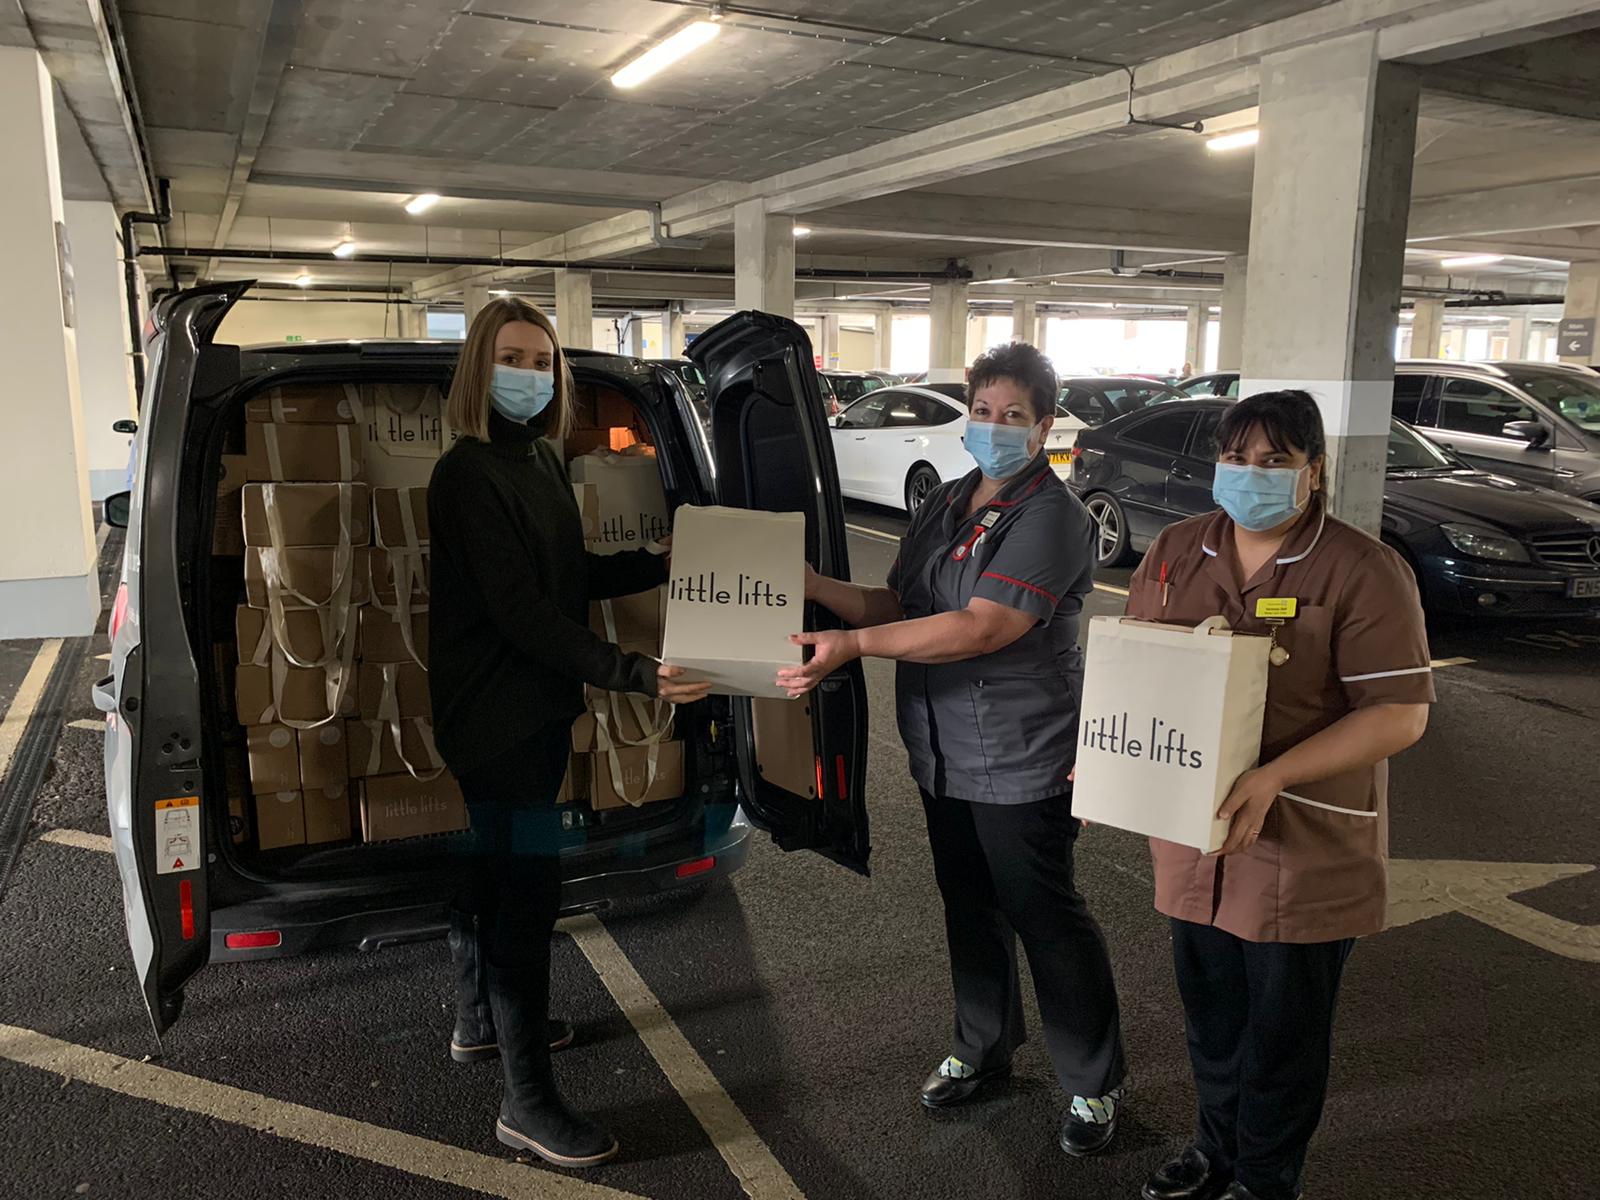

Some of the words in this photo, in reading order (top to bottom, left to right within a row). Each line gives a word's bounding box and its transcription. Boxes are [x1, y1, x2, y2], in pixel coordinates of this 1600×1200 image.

[368, 413, 416, 442] litle
[420, 413, 458, 441] lifs
[593, 514, 637, 543] ttle
[670, 571, 731, 604] little
[738, 573, 788, 607] lifts
[1083, 712, 1142, 757] little
[1149, 717, 1203, 769] lifts
[385, 797, 418, 818] little
[420, 794, 449, 814] lifts
